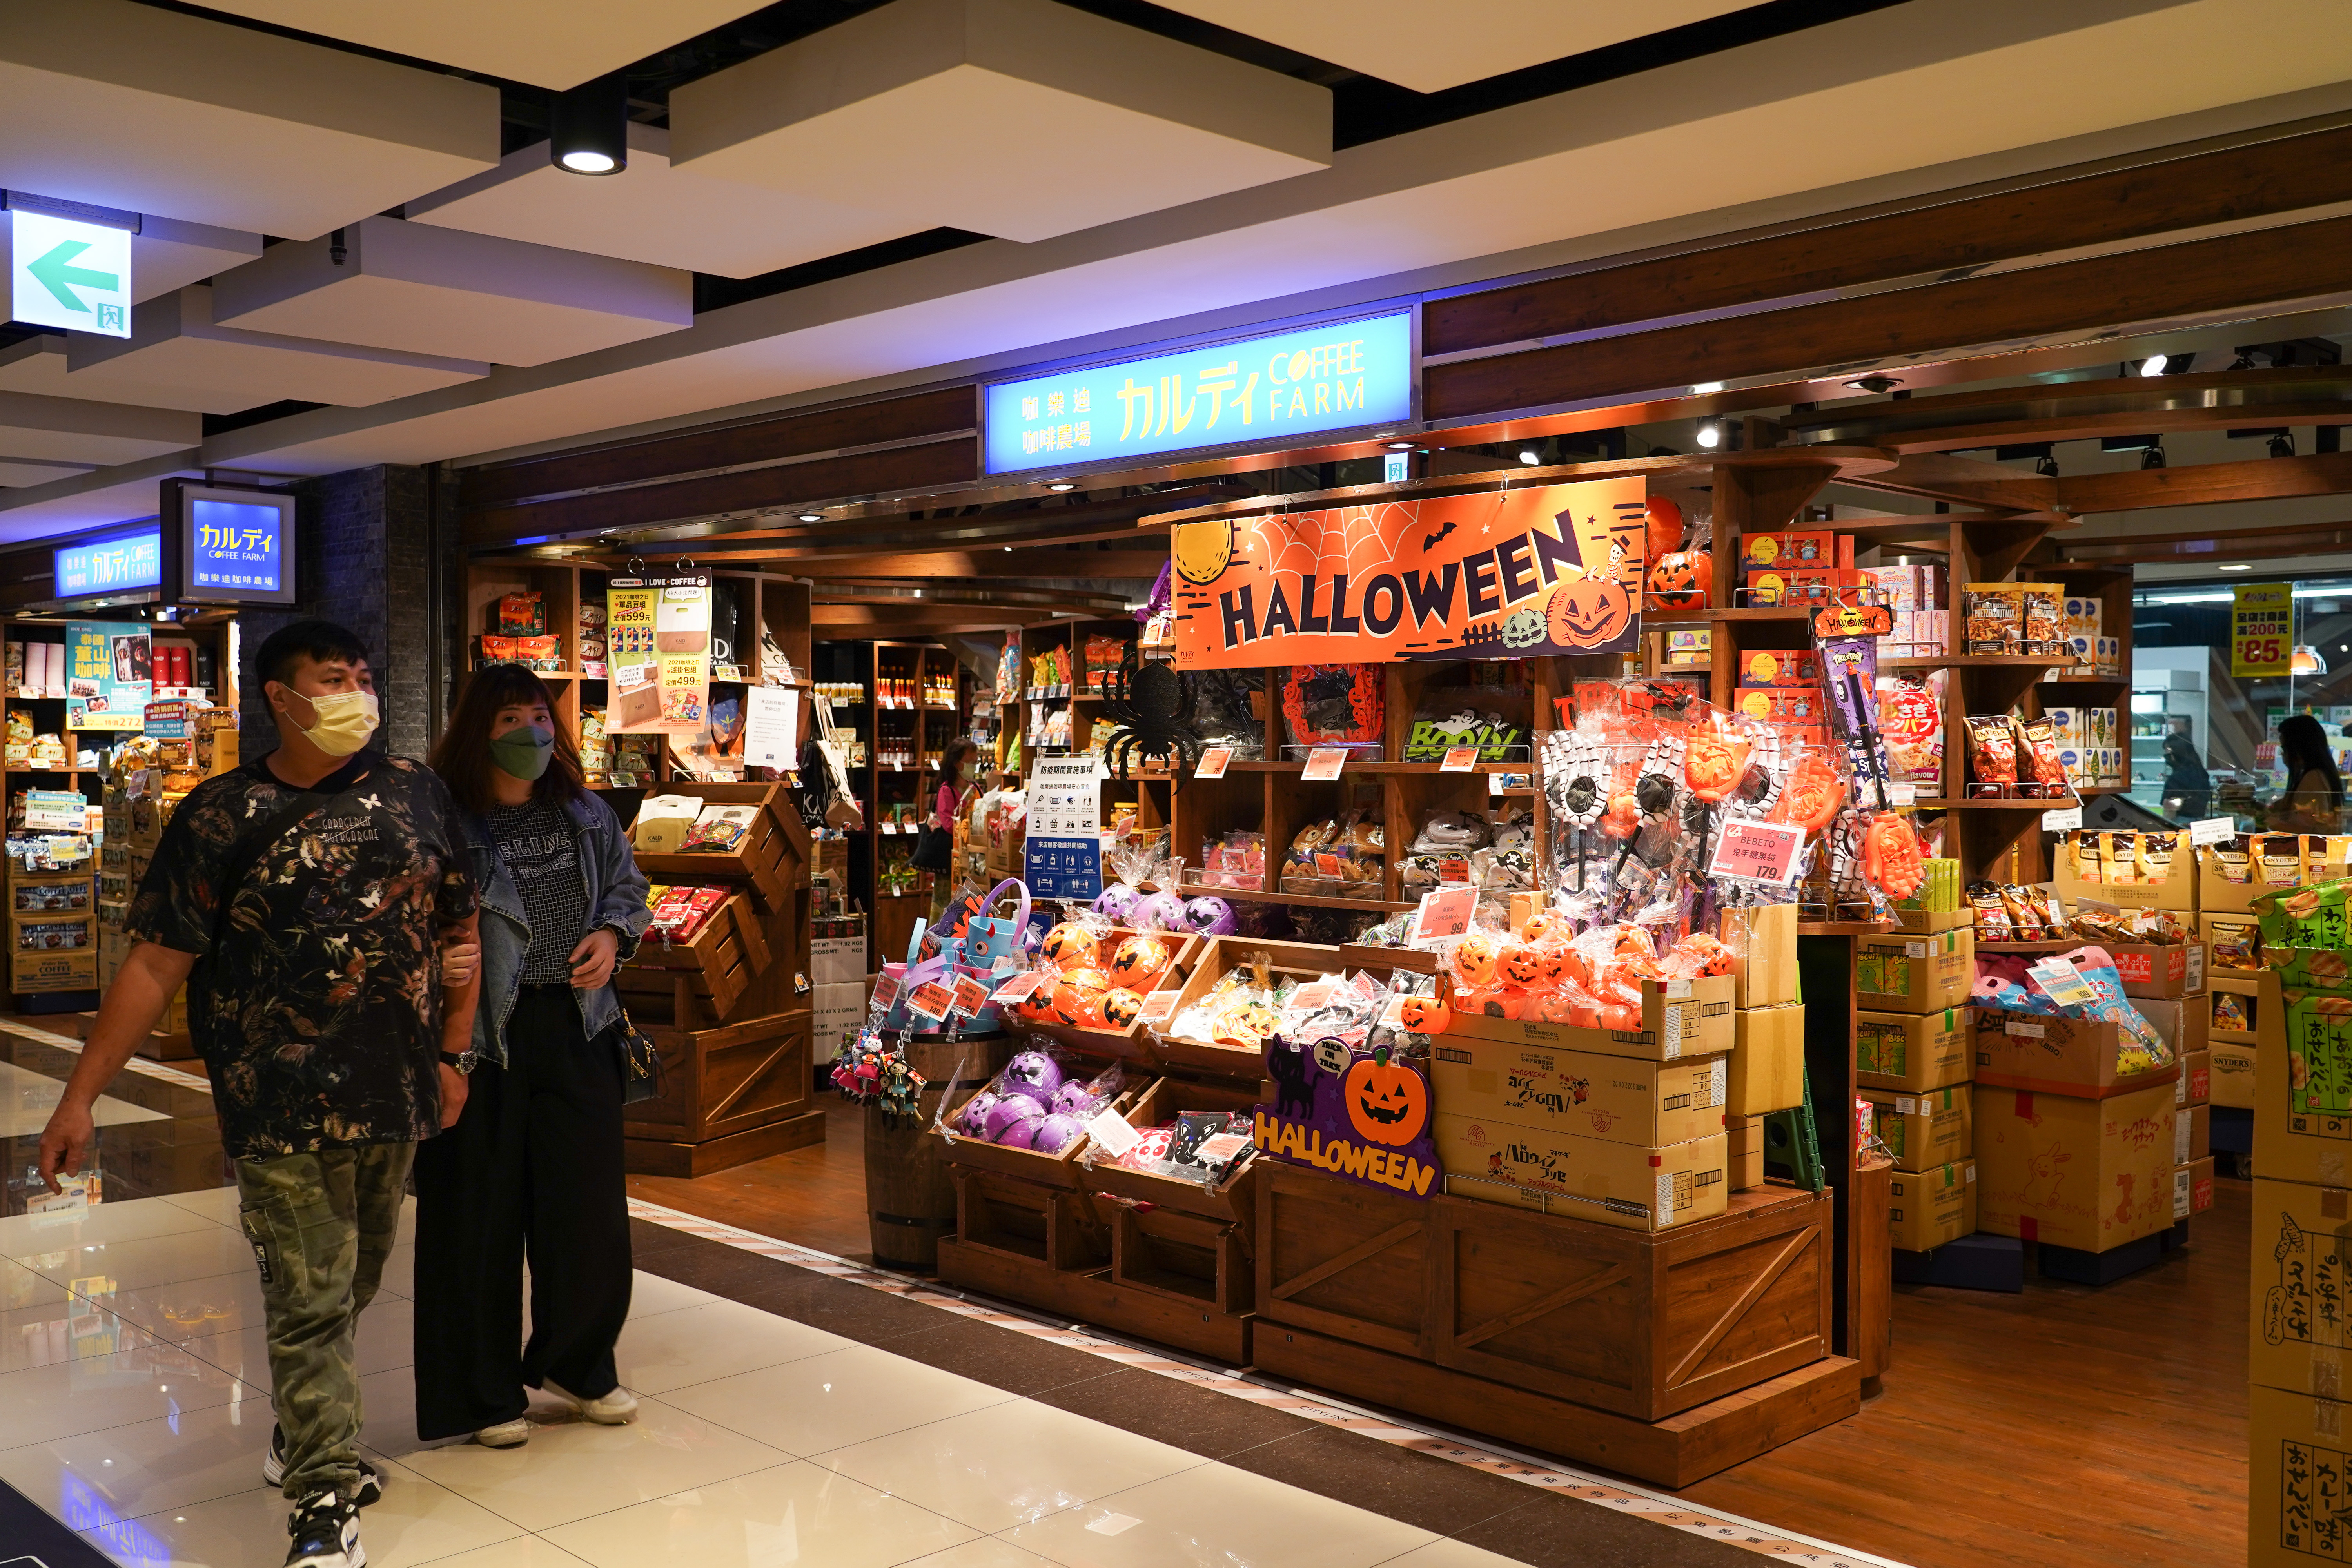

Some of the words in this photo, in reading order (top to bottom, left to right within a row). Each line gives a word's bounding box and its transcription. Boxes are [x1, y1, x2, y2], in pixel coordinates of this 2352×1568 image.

[1268, 339, 1365, 384] COFFEE
[1021, 386, 1092, 421] 咖樂迪
[1116, 360, 1259, 442] カルディ
[1269, 377, 1365, 421] FARM
[1022, 420, 1092, 455] 咖啡農場
[200, 524, 272, 552] カルディ
[209, 550, 238, 560] COFFEE
[243, 552, 265, 561] FARM
[131, 561, 154, 579] FARM
[200, 573, 273, 586] 咖樂迪咖啡農場
[1218, 508, 1584, 651] HALLOWEEN
[1826, 613, 1877, 634] HALLOWEEN
[81, 633, 104, 646] 泰國
[2244, 639, 2279, 663] 85
[75, 662, 111, 679] 咖啡
[666, 677, 701, 686] 定價499元
[1977, 729, 2007, 738] SNYDER'S
[1041, 766, 1093, 775] 防疫期間實施事項
[1911, 771, 1935, 779] flavour
[497, 832, 572, 861] ELINE
[1740, 836, 1775, 848] BEBETO
[1733, 848, 1776, 862] 鬼手糖果袋
[518, 853, 576, 879] TROPEZ
[2225, 866, 2246, 876] ieces
[2077, 990, 2090, 998] 199
[929, 1006, 940, 1015] 149
[1321, 1041, 1343, 1053] TRICK
[1325, 1050, 1335, 1060] OR
[1319, 1058, 1341, 1072] TRICK
[2214, 1058, 2249, 1067] SNYDER'S
[2306, 1020, 2330, 1094] おせんべい
[1510, 1068, 1547, 1079] アップルクリーム
[1518, 1089, 1570, 1113] ハロウィン
[1254, 1111, 1435, 1196] HALLOWEEN
[1505, 1143, 1556, 1167] ハロウィン
[1540, 1167, 1566, 1183] ブッセ
[1528, 1178, 1564, 1191] アップルクリーム
[781, 1253, 814, 1264] CITYLINK
[864, 1278, 902, 1289] CITYLINK
[2315, 1254, 2340, 1328] あおさの
[956, 1305, 995, 1318] CITYLINK
[1058, 1334, 1102, 1348] CITYLINK
[1172, 1368, 1220, 1384] CITYLINK
[1299, 1405, 1353, 1423] CITYLINK
[2286, 1445, 2311, 1532] おせんべい
[2314, 1462, 2341, 1552] カレー味の
